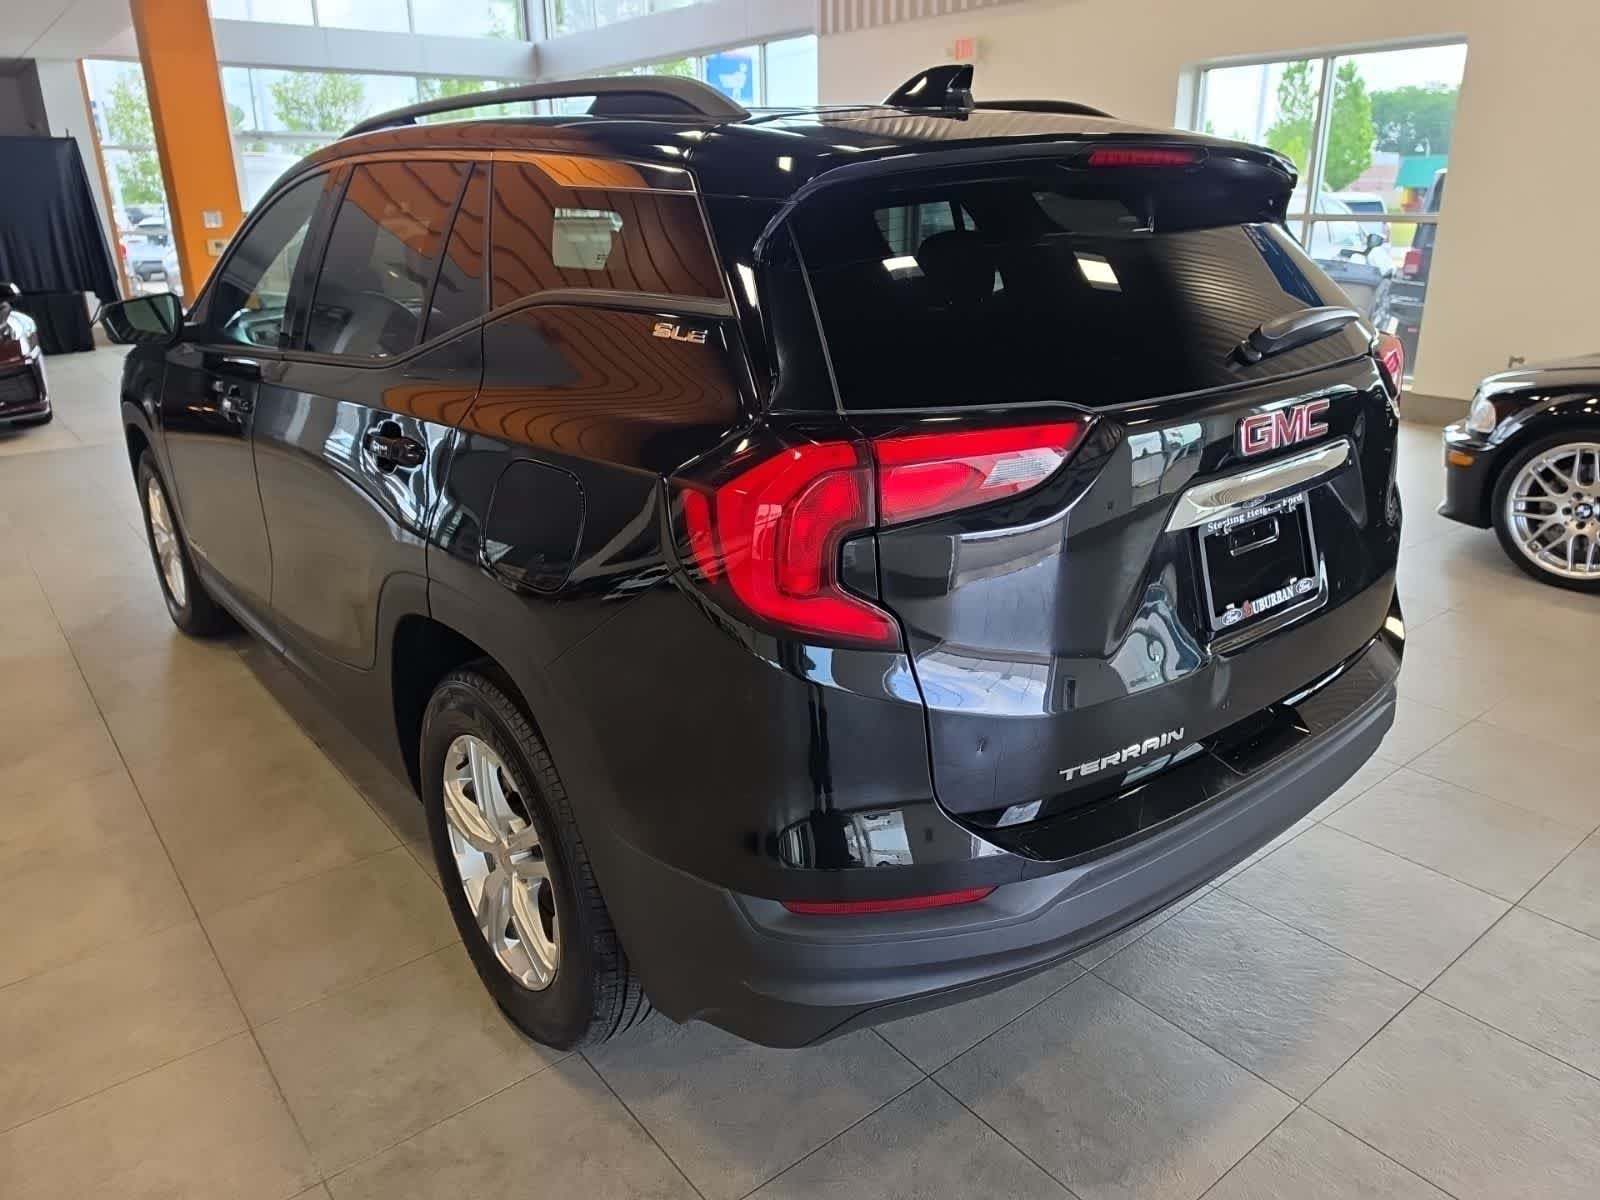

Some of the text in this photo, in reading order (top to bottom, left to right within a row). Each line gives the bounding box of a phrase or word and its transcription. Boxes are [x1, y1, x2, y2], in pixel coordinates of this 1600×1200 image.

[652, 322, 708, 344] SLE
[1241, 398, 1330, 456] GMC
[1207, 512, 1246, 533] Sterling
[1247, 501, 1282, 518] Heig
[1059, 727, 1185, 781] TERRAIN
